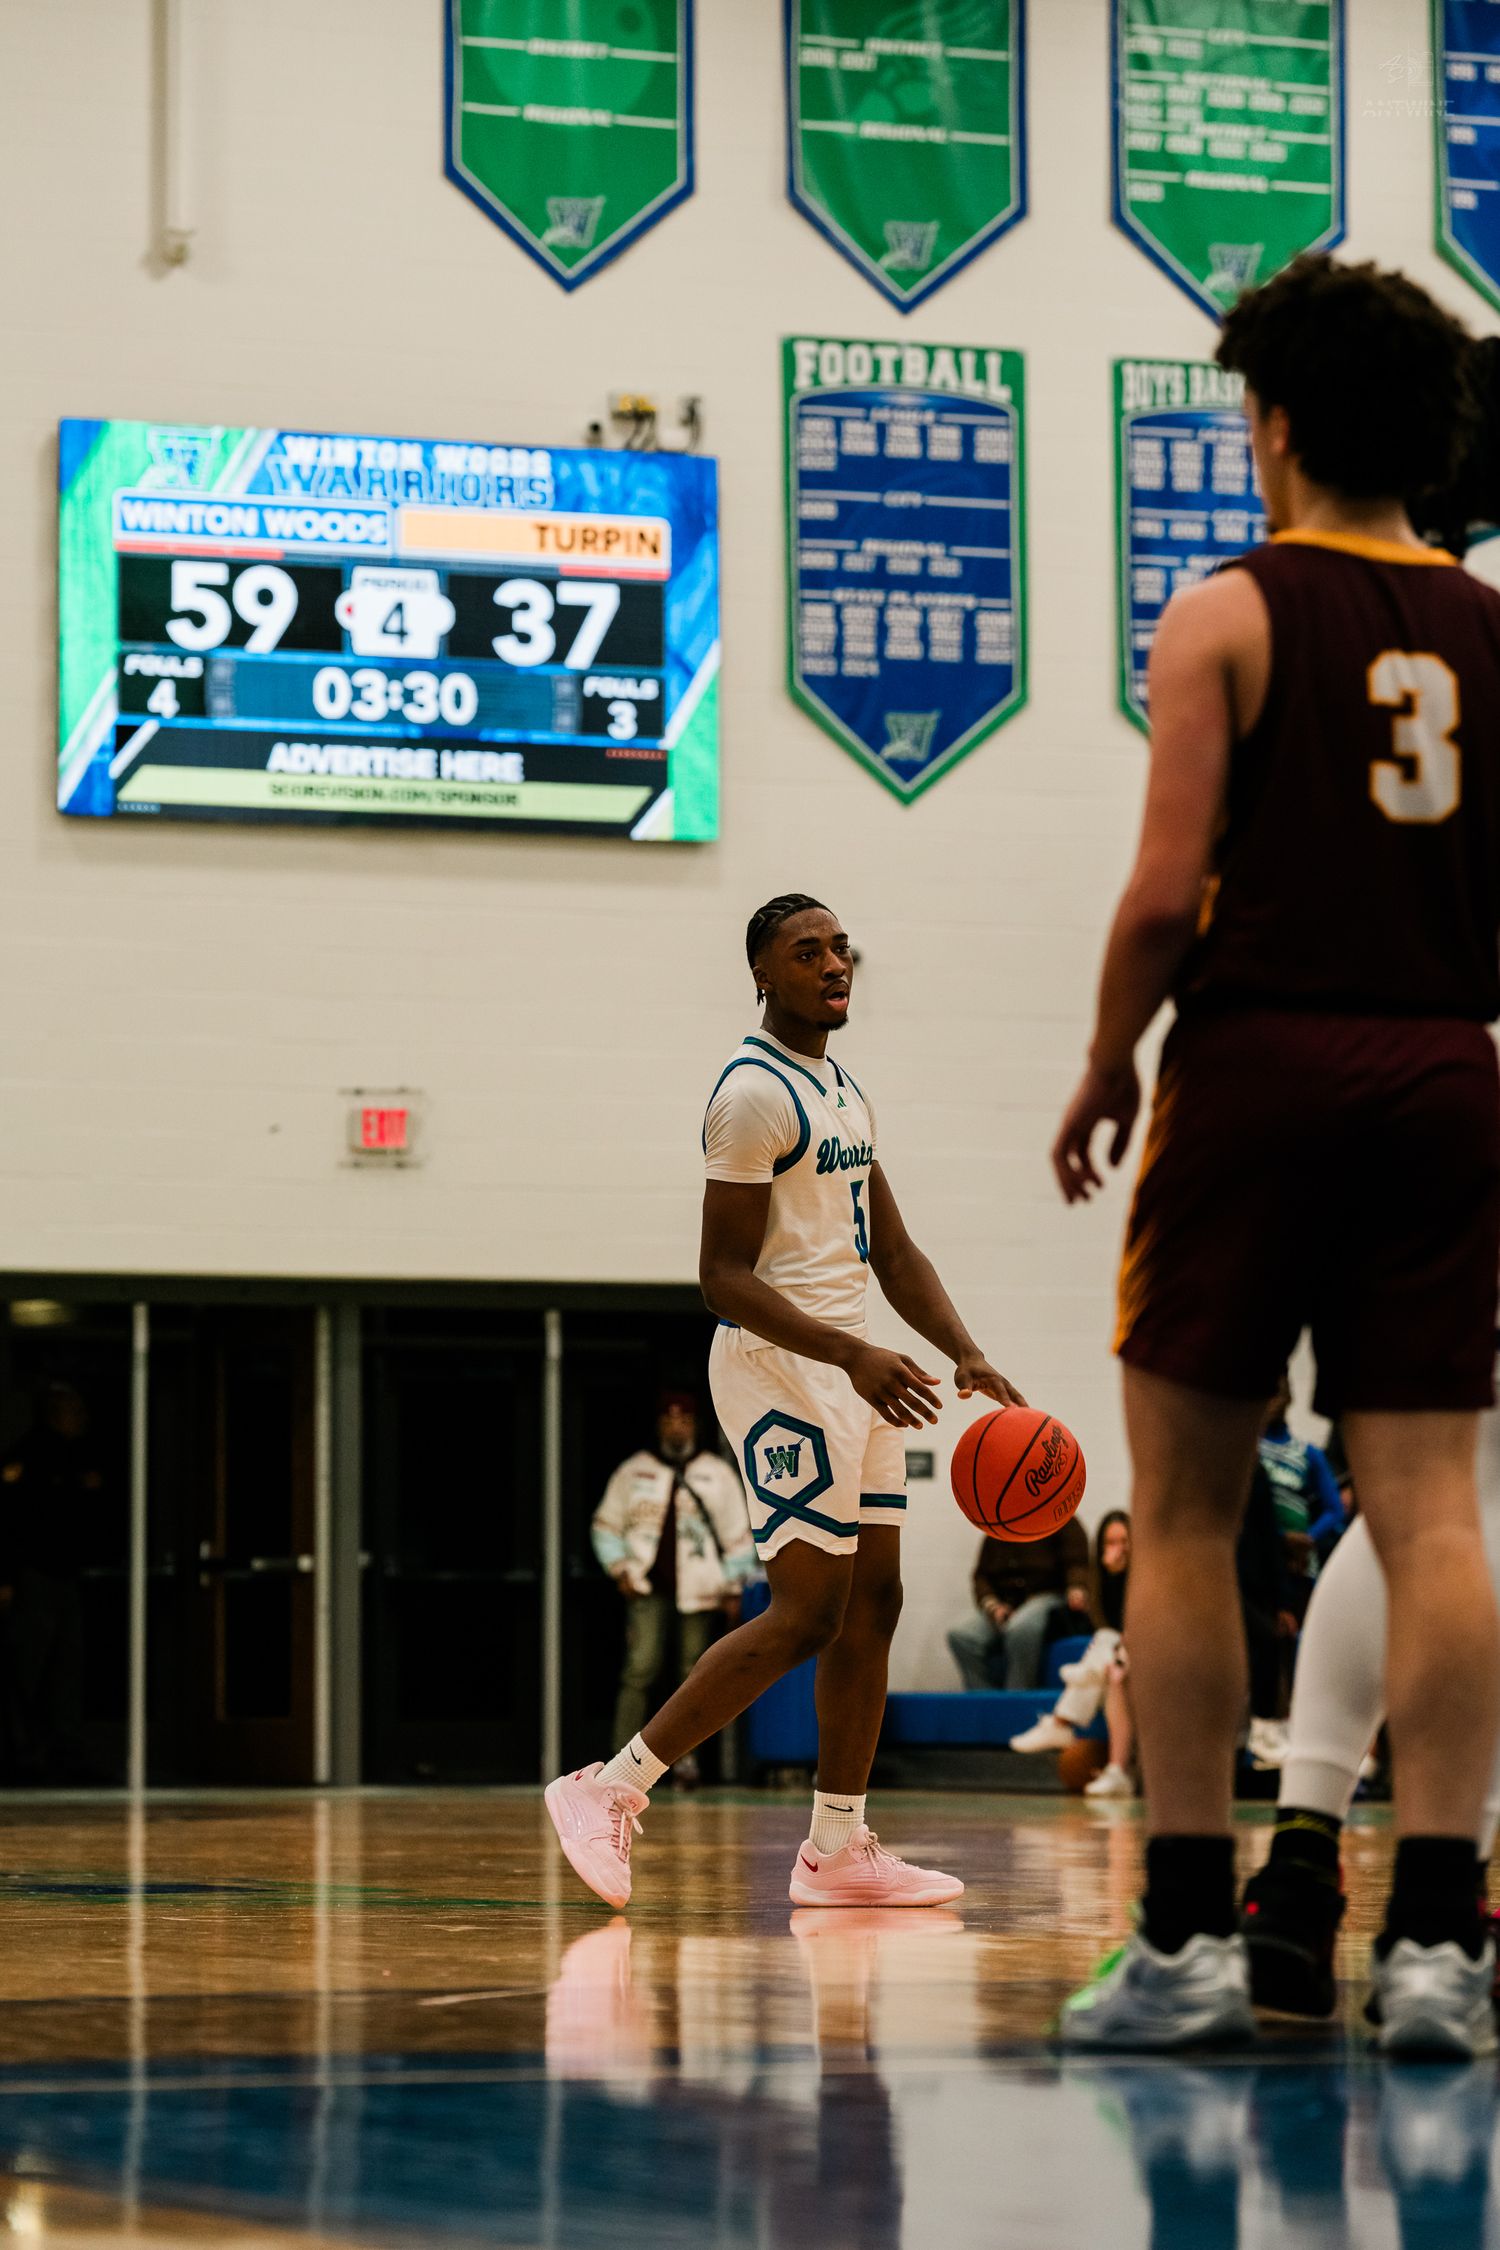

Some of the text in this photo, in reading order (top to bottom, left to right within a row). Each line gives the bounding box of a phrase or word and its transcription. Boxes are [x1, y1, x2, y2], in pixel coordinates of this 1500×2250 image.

[793, 339, 1012, 403] FOOTBALL
[266, 453, 555, 509] WARRIORS
[282, 435, 551, 477] WINTON WOODS
[121, 500, 388, 544] WINTON WOODS
[533, 522, 661, 556] TURPIN
[166, 559, 298, 654] 59
[381, 601, 409, 645] 4
[492, 578, 621, 670] 37
[147, 678, 181, 719] 4
[312, 666, 479, 727] 03:30
[606, 699, 638, 741] 3
[1366, 648, 1462, 824] 3
[266, 741, 525, 784] ADVERTISE HERE
[849, 1179, 869, 1264] 5
